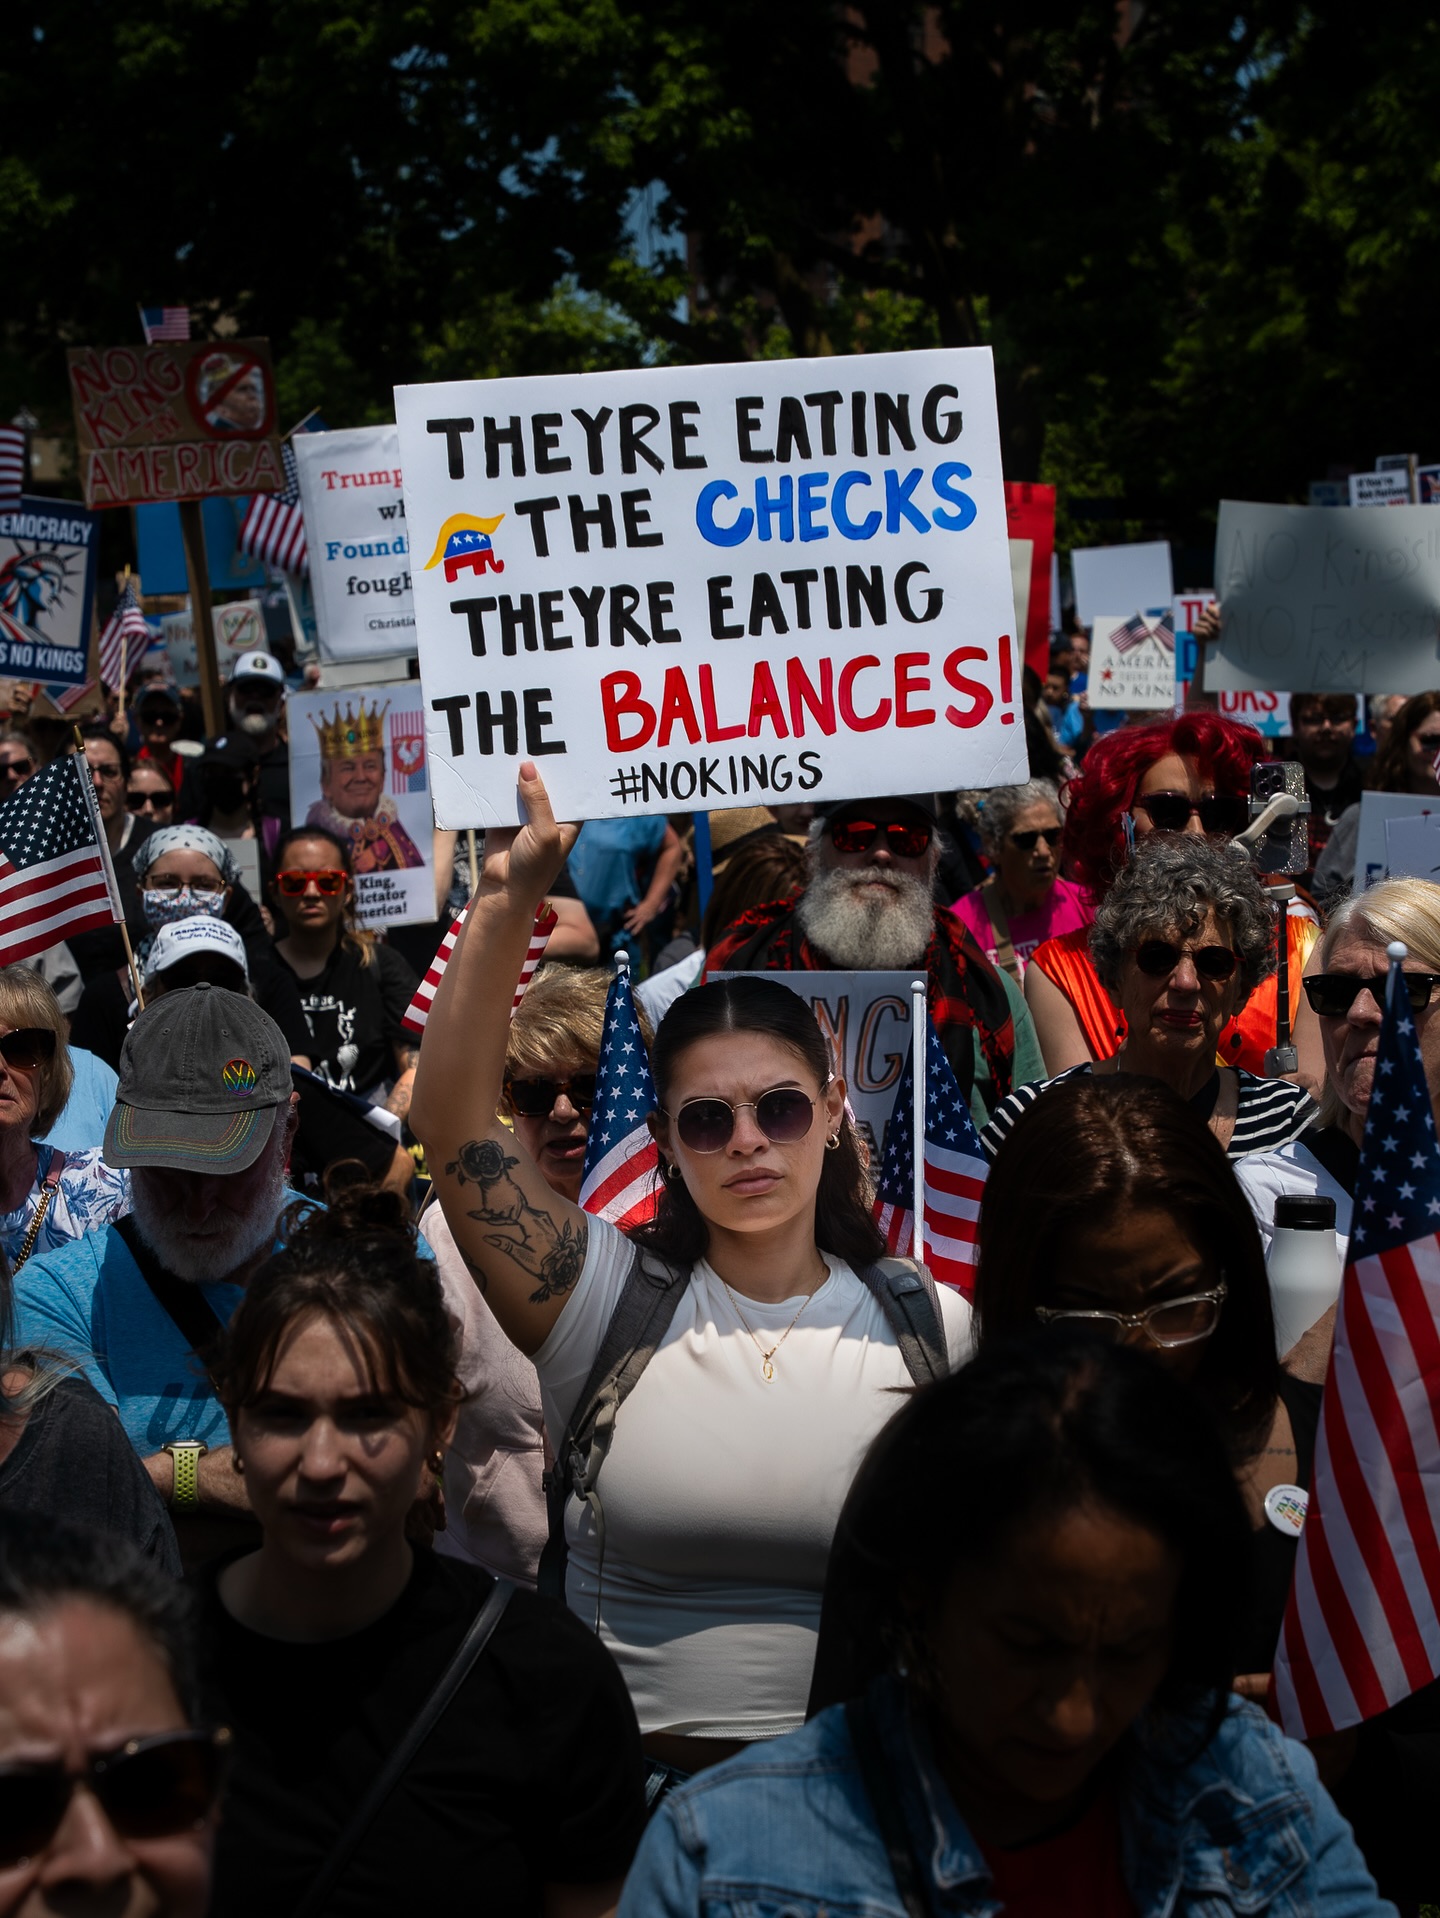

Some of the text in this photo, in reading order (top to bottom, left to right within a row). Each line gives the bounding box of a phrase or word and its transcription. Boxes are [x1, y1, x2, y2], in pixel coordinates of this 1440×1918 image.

[70, 345, 138, 404] NO
[426, 383, 963, 480] THEYRE EATING
[87, 440, 285, 503] AMERICA
[514, 461, 977, 557] THE CHECKS
[1227, 530, 1299, 589] NO
[449, 561, 943, 657] THEYRE EATING
[9, 644, 34, 667] NO
[35, 646, 85, 674] KINGS
[431, 635, 1015, 757] THE BALANCES!
[609, 751, 823, 804] #NOKINGS
